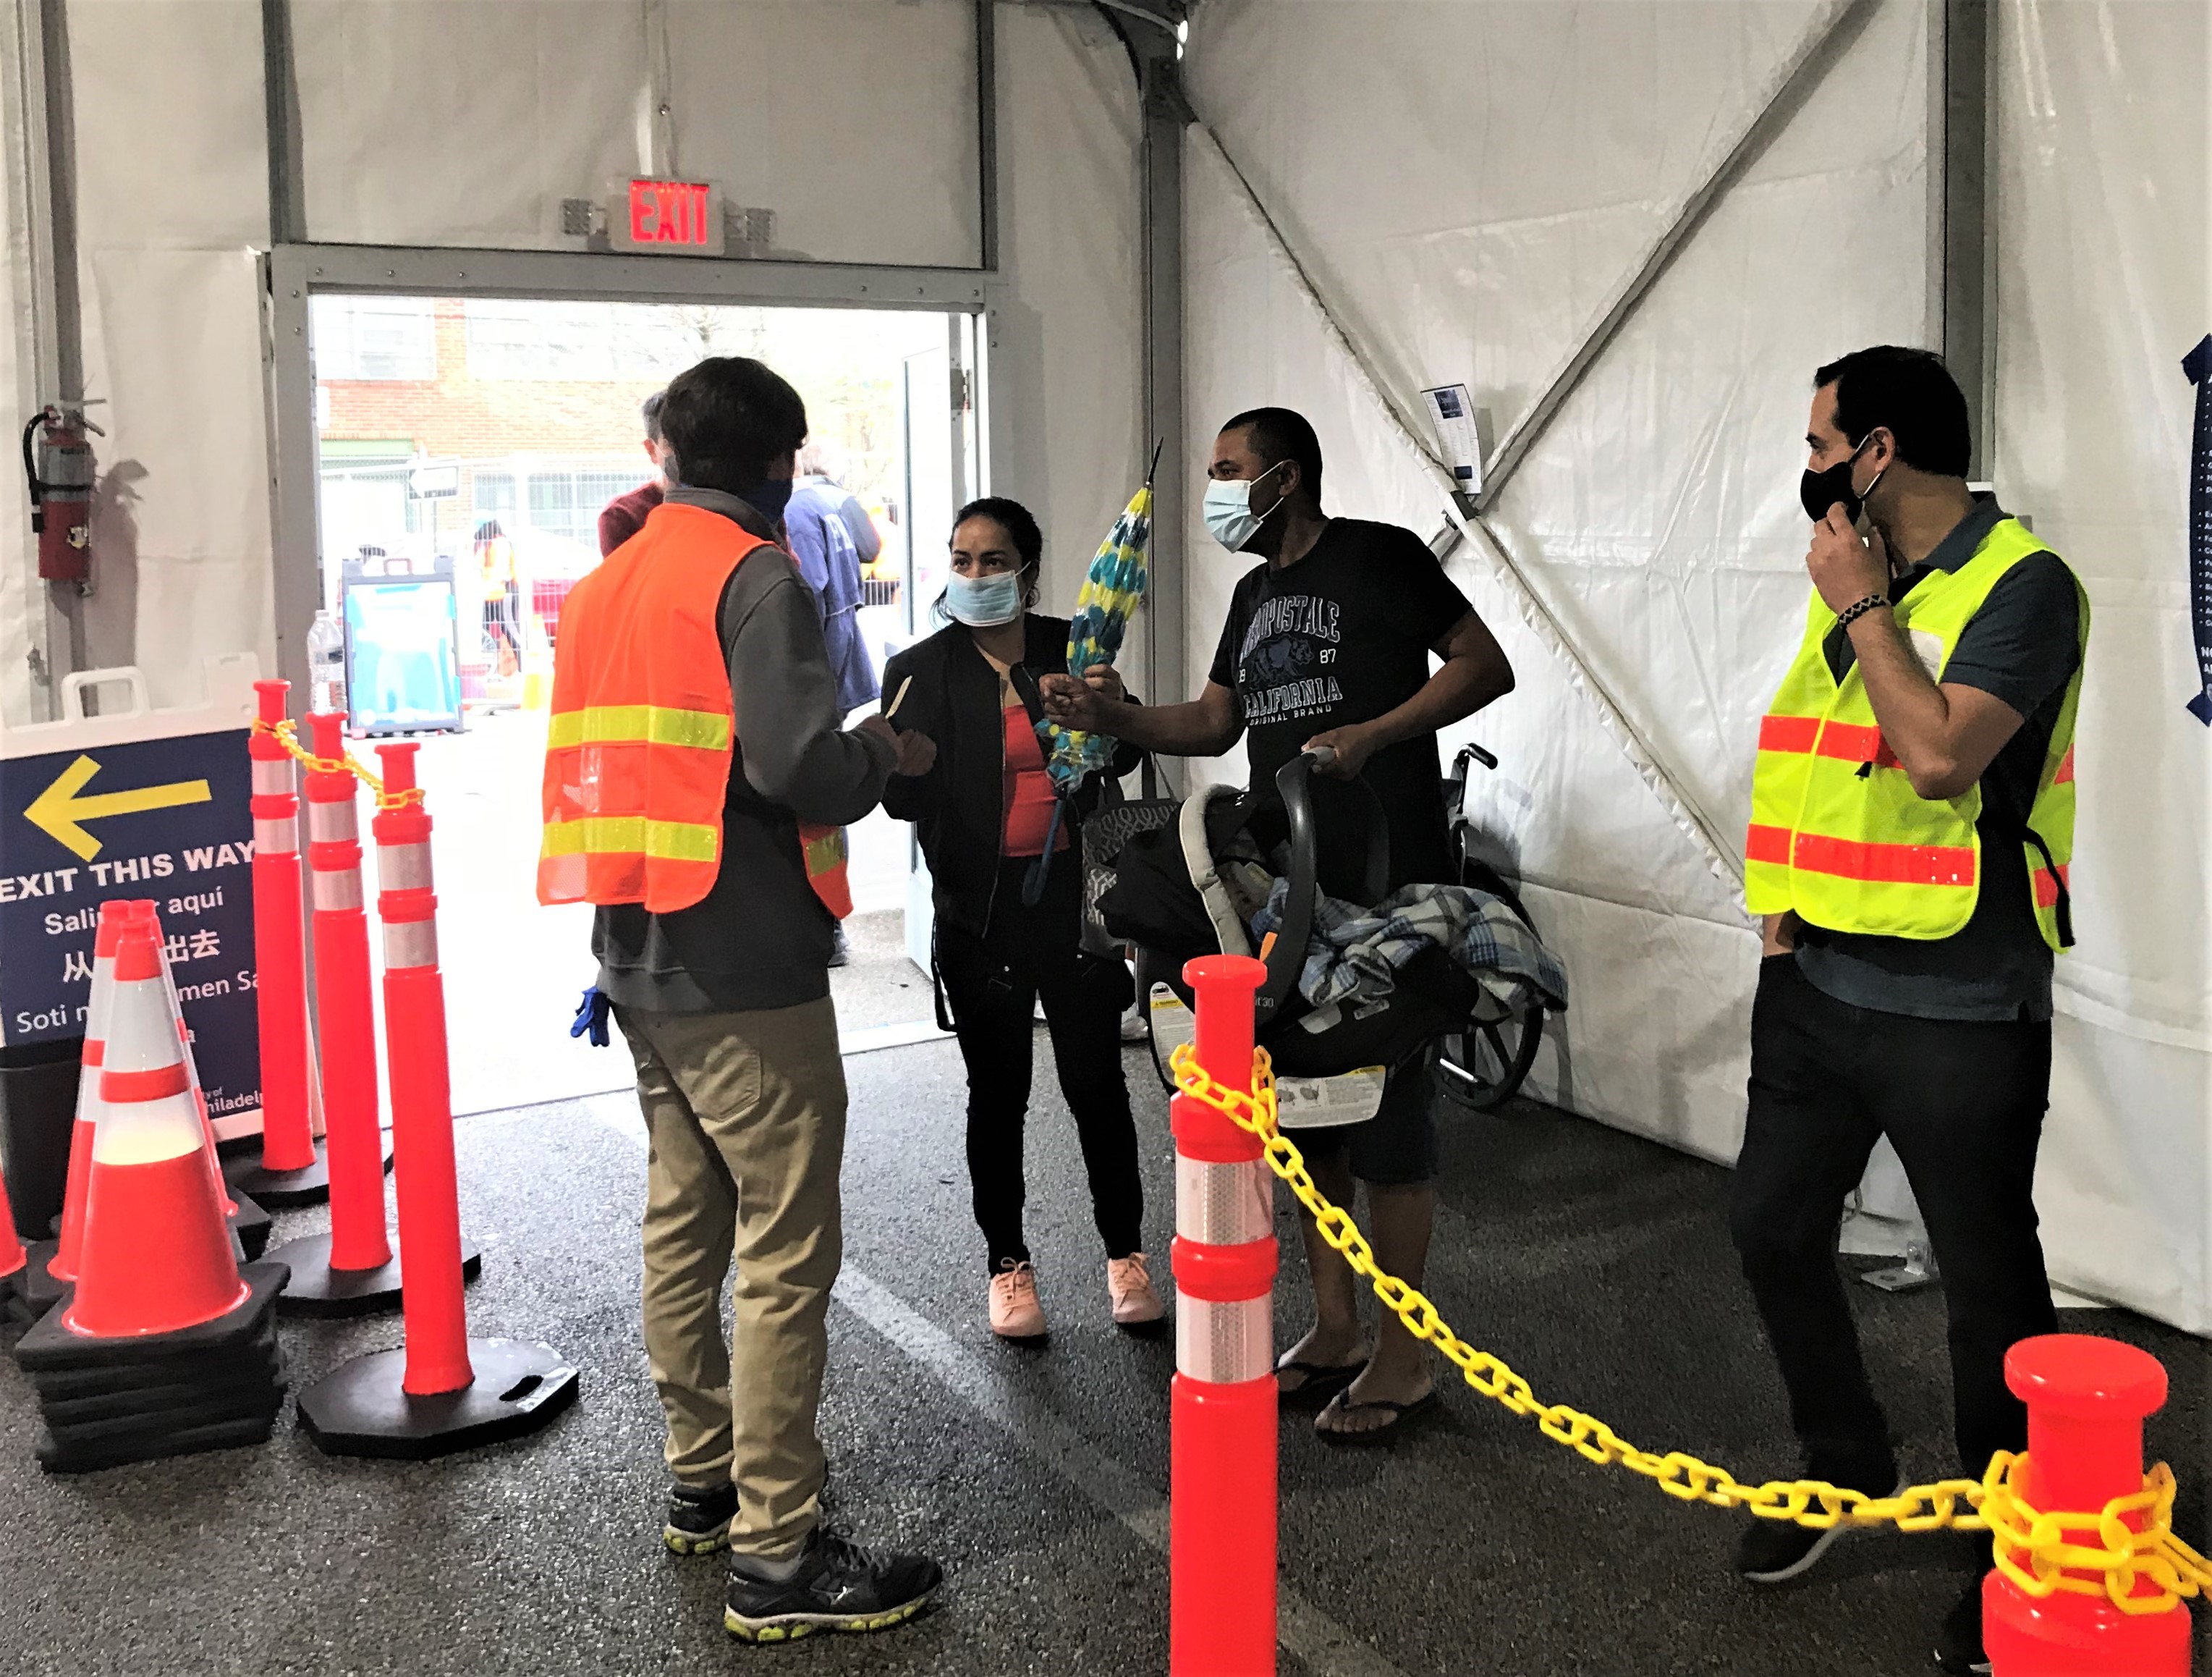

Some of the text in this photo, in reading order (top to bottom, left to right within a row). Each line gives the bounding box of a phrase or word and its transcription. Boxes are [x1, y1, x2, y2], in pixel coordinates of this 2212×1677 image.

[630, 179, 709, 244] EXIT
[1320, 648, 1336, 664] 87
[1243, 676, 1343, 719] CALIFORNIA
[1250, 704, 1332, 726] ORIGINAL BRAND
[0, 840, 255, 903] EXIT THIS WAY
[168, 886, 224, 916] aquí
[17, 1005, 67, 1034] Soti
